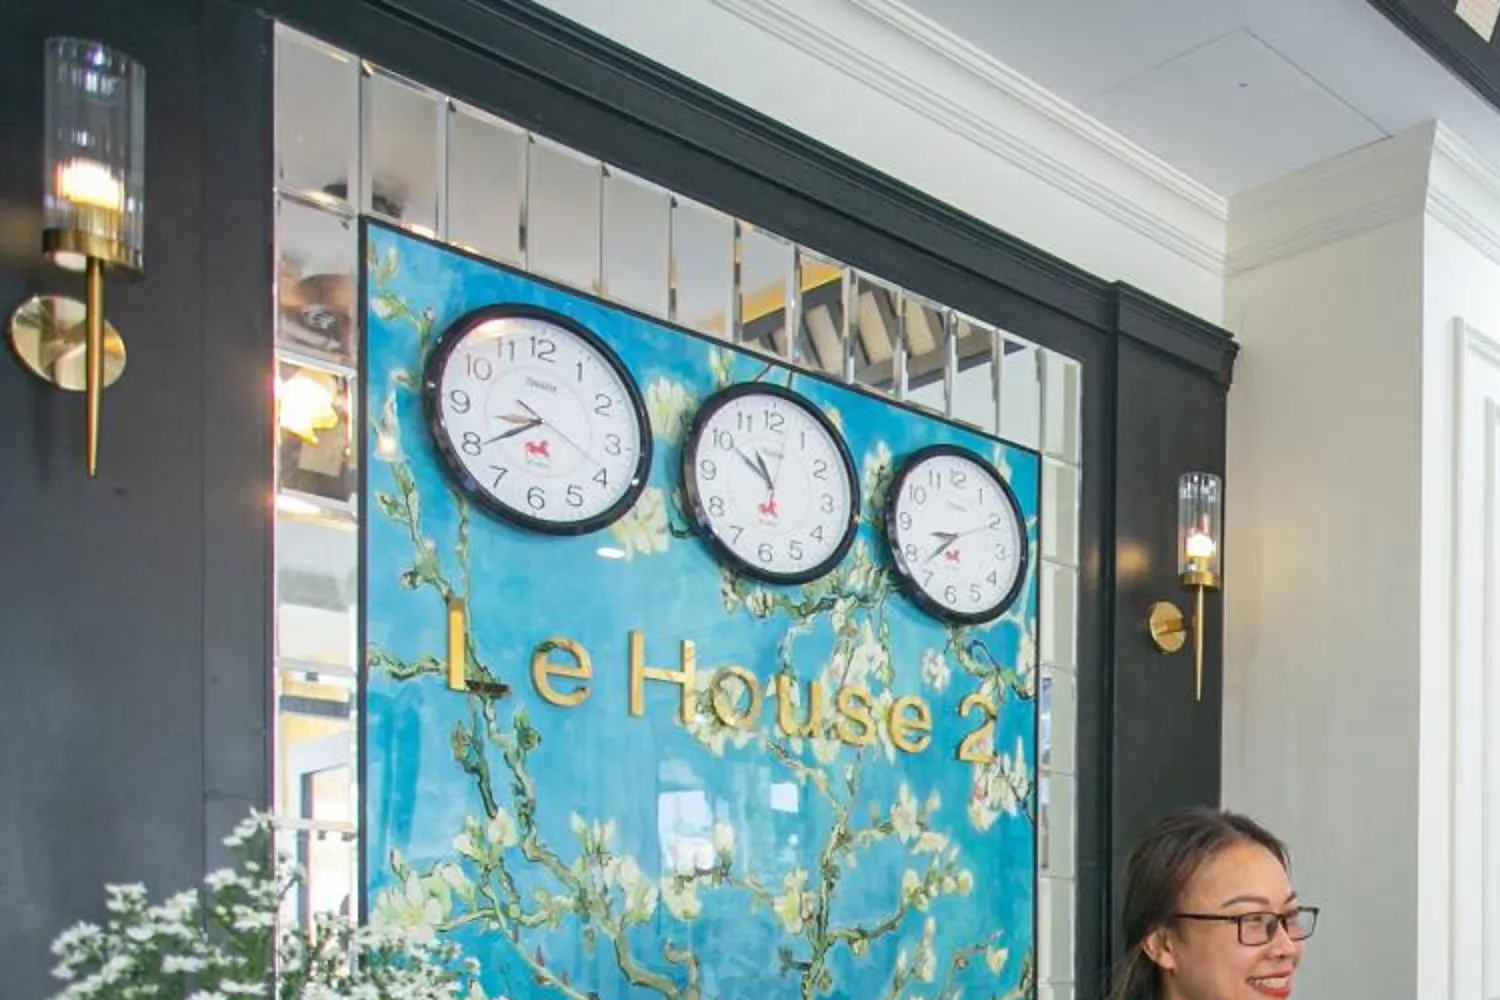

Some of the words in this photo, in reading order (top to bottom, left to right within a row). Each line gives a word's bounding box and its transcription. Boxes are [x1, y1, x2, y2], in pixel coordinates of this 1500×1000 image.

[497, 338, 516, 362] 11
[531, 336, 557, 363] 12
[466, 354, 492, 381] 10
[576, 361, 583, 382] 1
[450, 389, 471, 414] 9
[594, 393, 613, 416] 2
[737, 411, 752, 433] 11
[764, 410, 785, 433] 12
[461, 431, 482, 456] 8
[605, 433, 622, 456] 3
[713, 428, 734, 451] 10
[800, 431, 806, 449] 1
[488, 464, 509, 488] 7
[592, 467, 608, 489] 4
[700, 459, 717, 481] 9
[813, 459, 827, 481] 2
[929, 469, 941, 490] 11
[950, 468, 967, 490] 12
[527, 486, 545, 511] 6
[565, 483, 584, 507] 5
[820, 493, 835, 514] 3
[909, 484, 927, 505] 10
[978, 487, 984, 505] 1
[708, 495, 725, 518] 8
[899, 511, 913, 531] 9
[988, 512, 1001, 531] 2
[730, 525, 745, 545] 7
[810, 524, 823, 543] 4
[757, 543, 774, 563] 6
[788, 540, 804, 560] 5
[905, 543, 918, 563] 8
[994, 543, 1007, 561] 3
[922, 568, 934, 588] 7
[986, 570, 997, 587] 4
[944, 585, 957, 605] 6
[969, 583, 981, 603] 5
[447, 597, 593, 708] Le
[627, 629, 933, 753] House
[955, 691, 997, 764] 2
